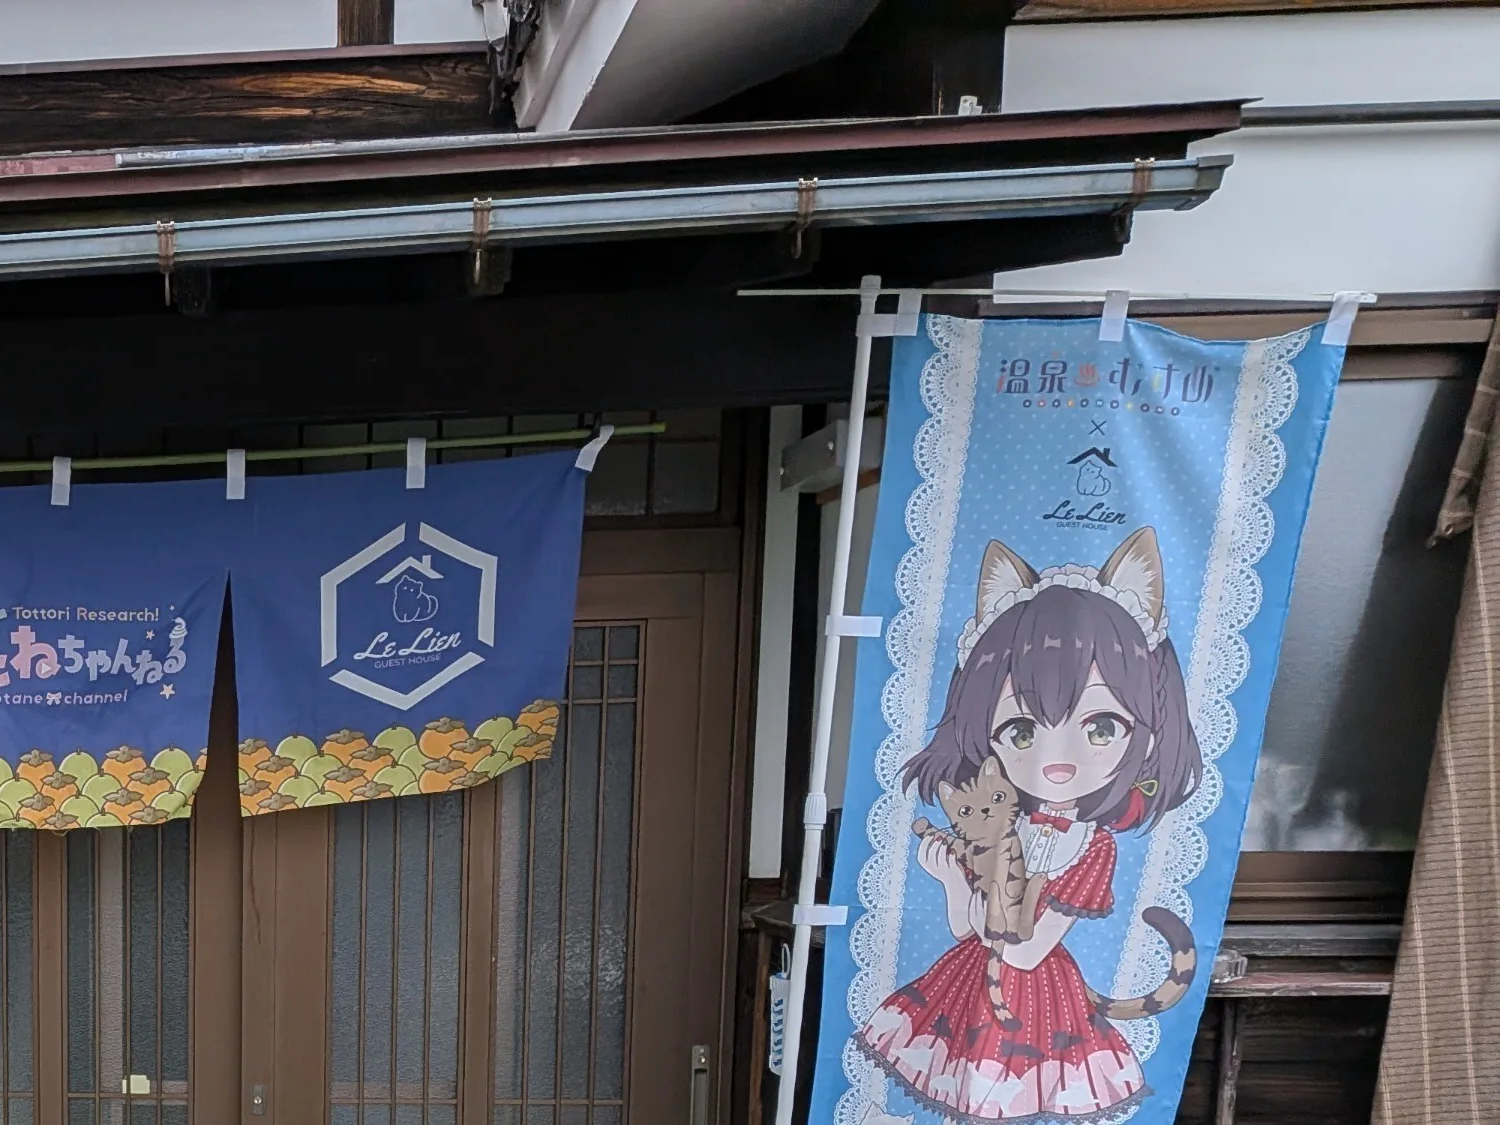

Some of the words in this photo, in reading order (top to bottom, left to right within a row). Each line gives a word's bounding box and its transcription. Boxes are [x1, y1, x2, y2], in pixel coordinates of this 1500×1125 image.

[1056, 521, 1081, 529] GUEST
[1082, 522, 1108, 531] HOUSE
[11, 606, 71, 622] Tottori
[76, 606, 160, 622] Research!
[374, 658, 406, 669] GUEST
[408, 653, 442, 665] HOUSE
[64, 689, 129, 705] channel
